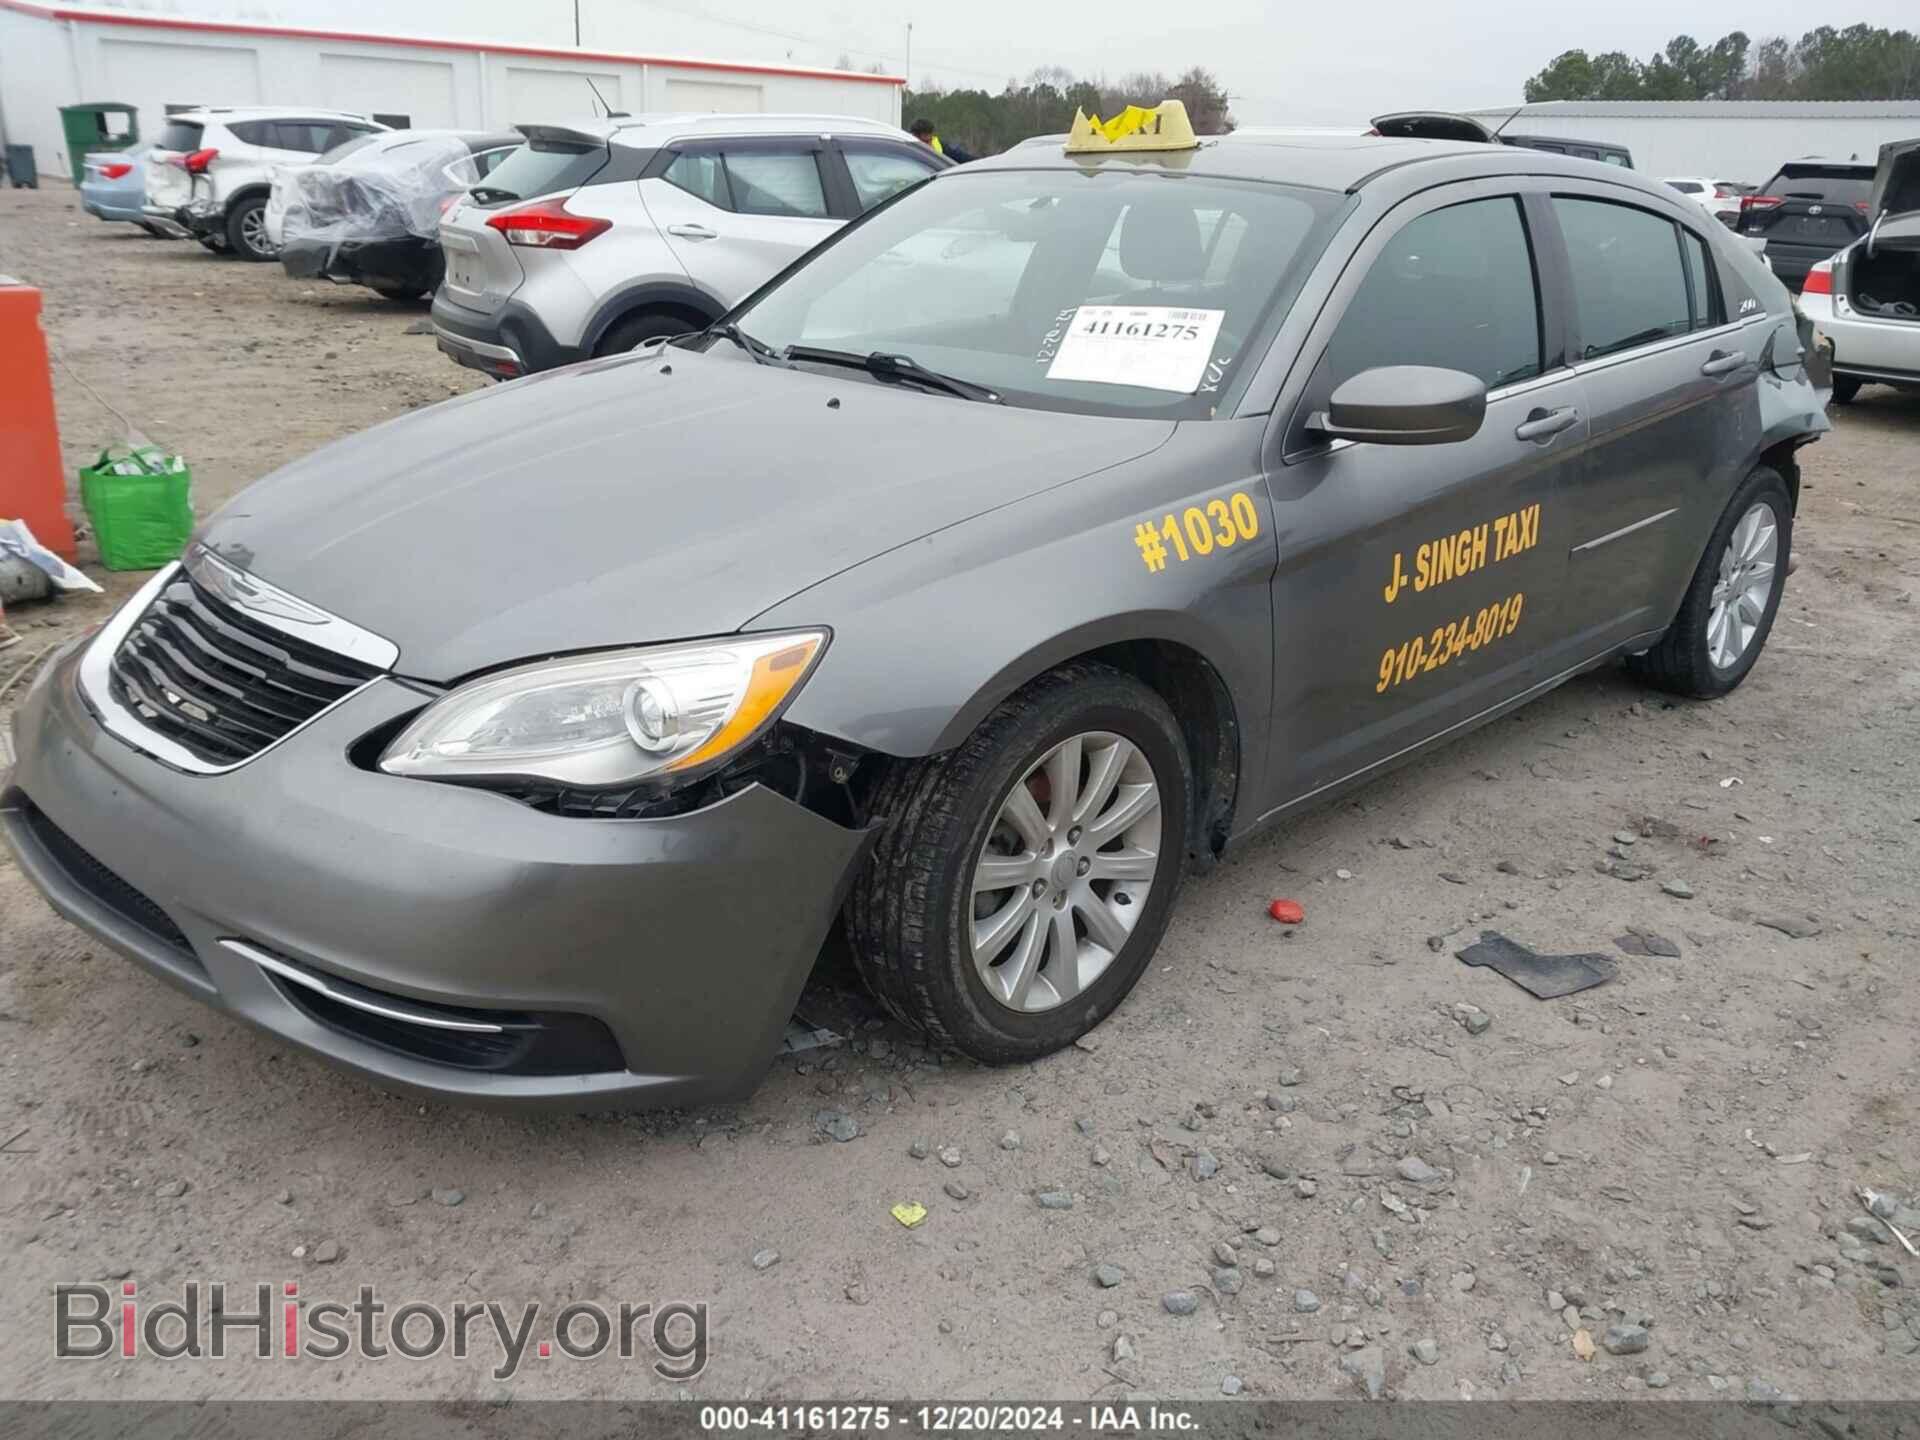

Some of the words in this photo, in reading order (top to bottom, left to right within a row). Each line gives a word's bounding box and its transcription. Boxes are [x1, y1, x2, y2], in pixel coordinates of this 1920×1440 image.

[1083, 320, 1200, 341] 41161275
[1134, 491, 1259, 573] #1030
[1384, 552, 1409, 604] J-
[1414, 525, 1489, 592] SINGH
[1494, 504, 1541, 562] TAXI
[1376, 592, 1524, 694] 910-234-8019
